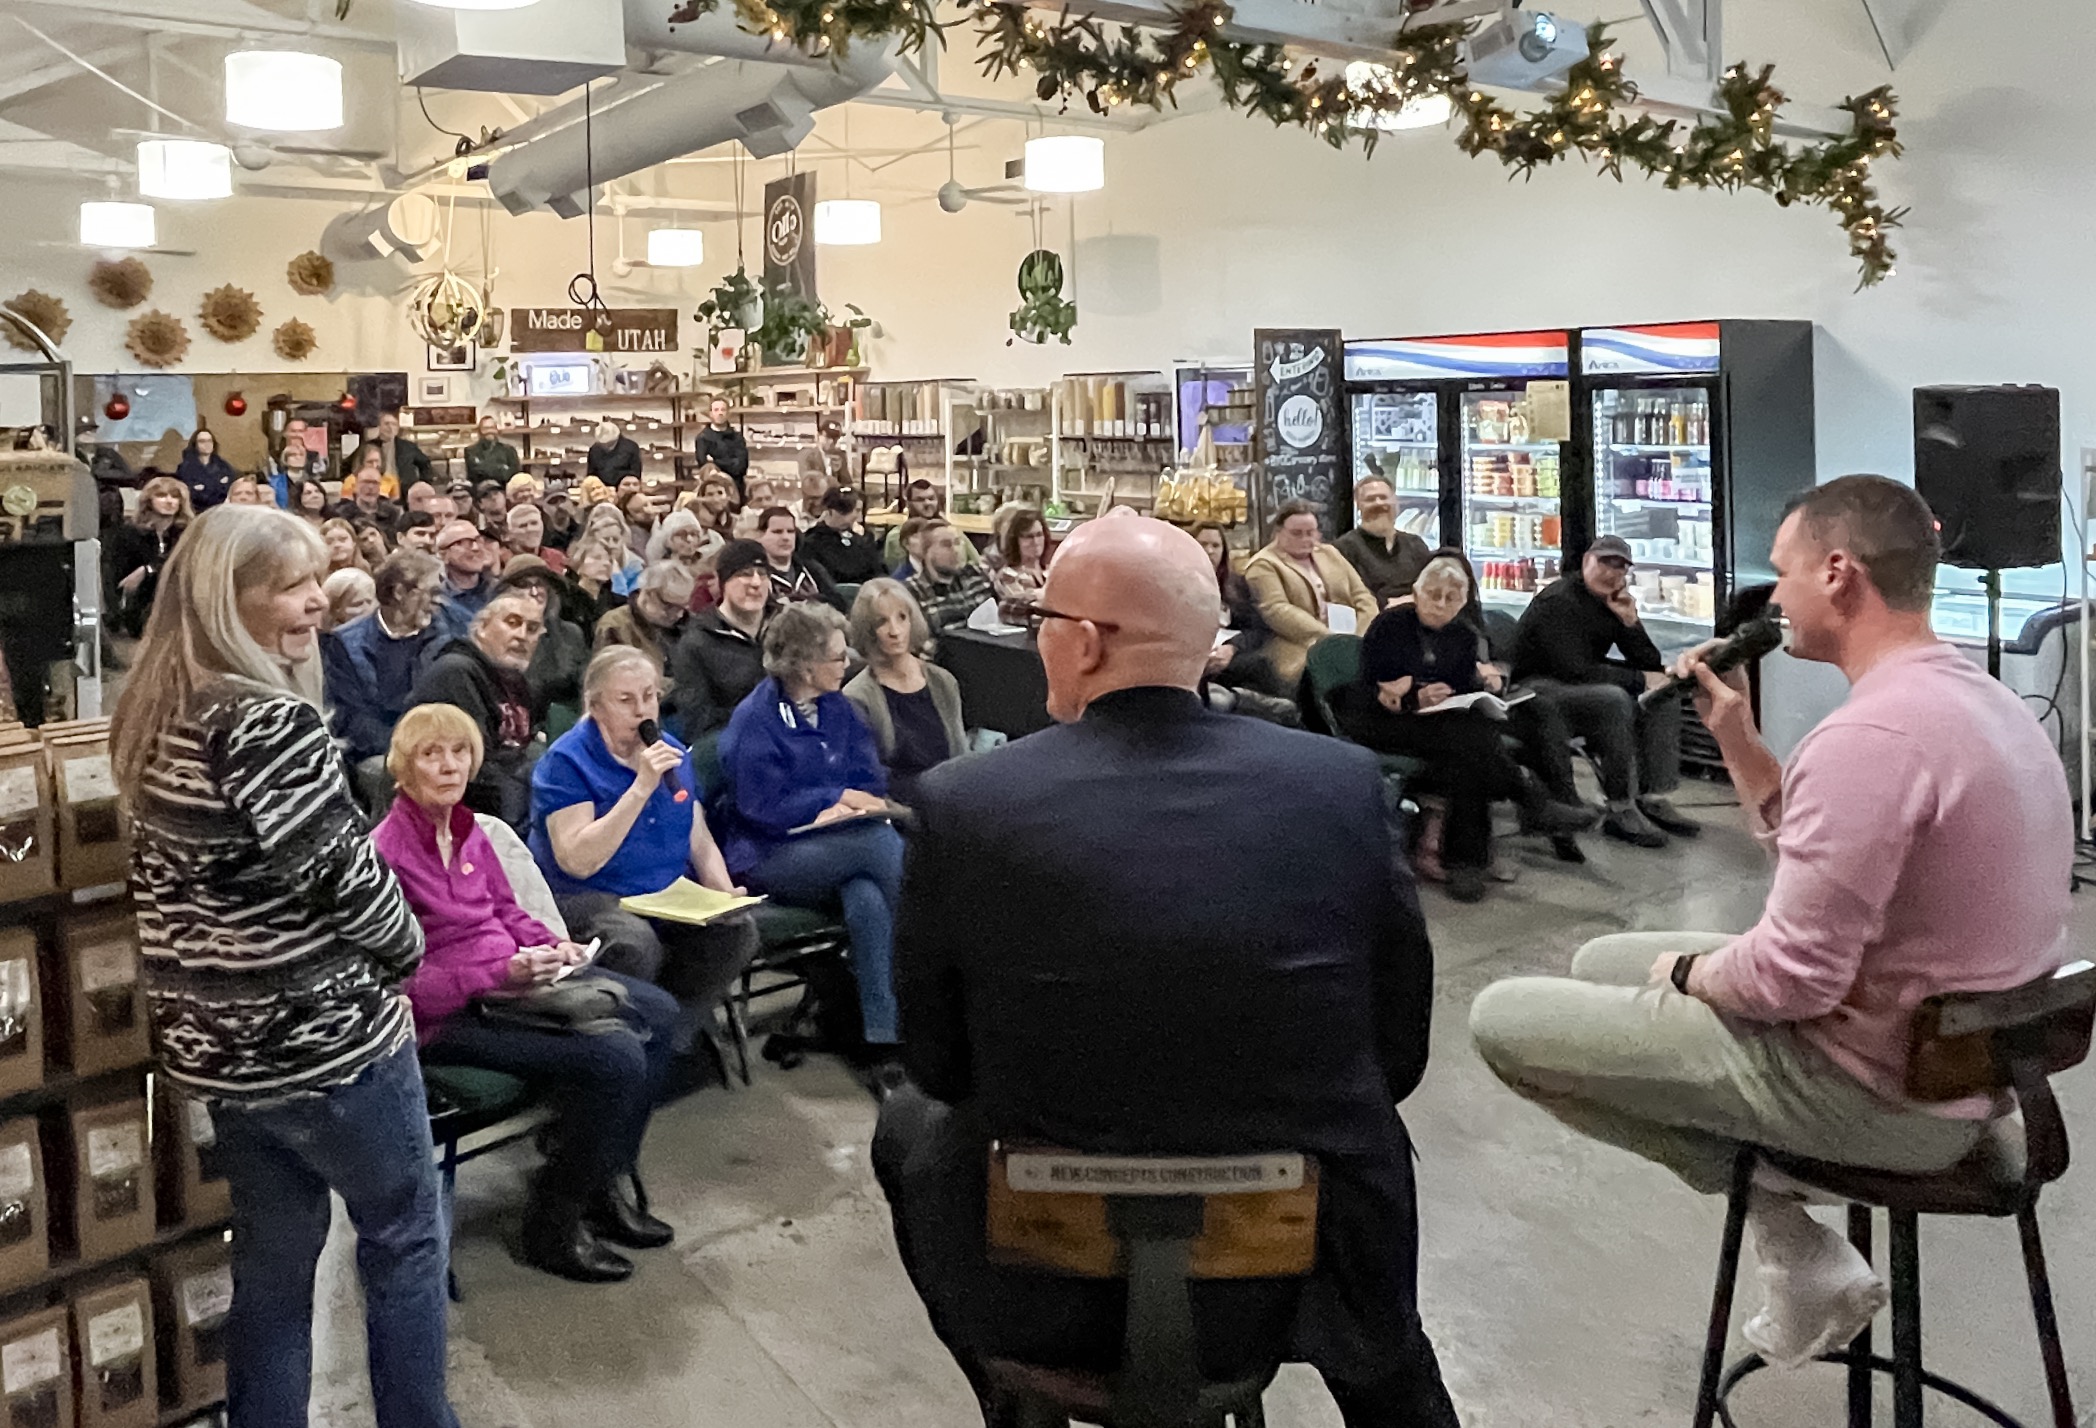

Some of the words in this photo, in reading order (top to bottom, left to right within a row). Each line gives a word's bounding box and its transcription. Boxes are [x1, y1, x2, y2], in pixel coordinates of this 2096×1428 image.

[528, 309, 583, 330] Made
[617, 329, 667, 351] UTAH
[1159, 1163, 1263, 1184] CONSTRUCTION
